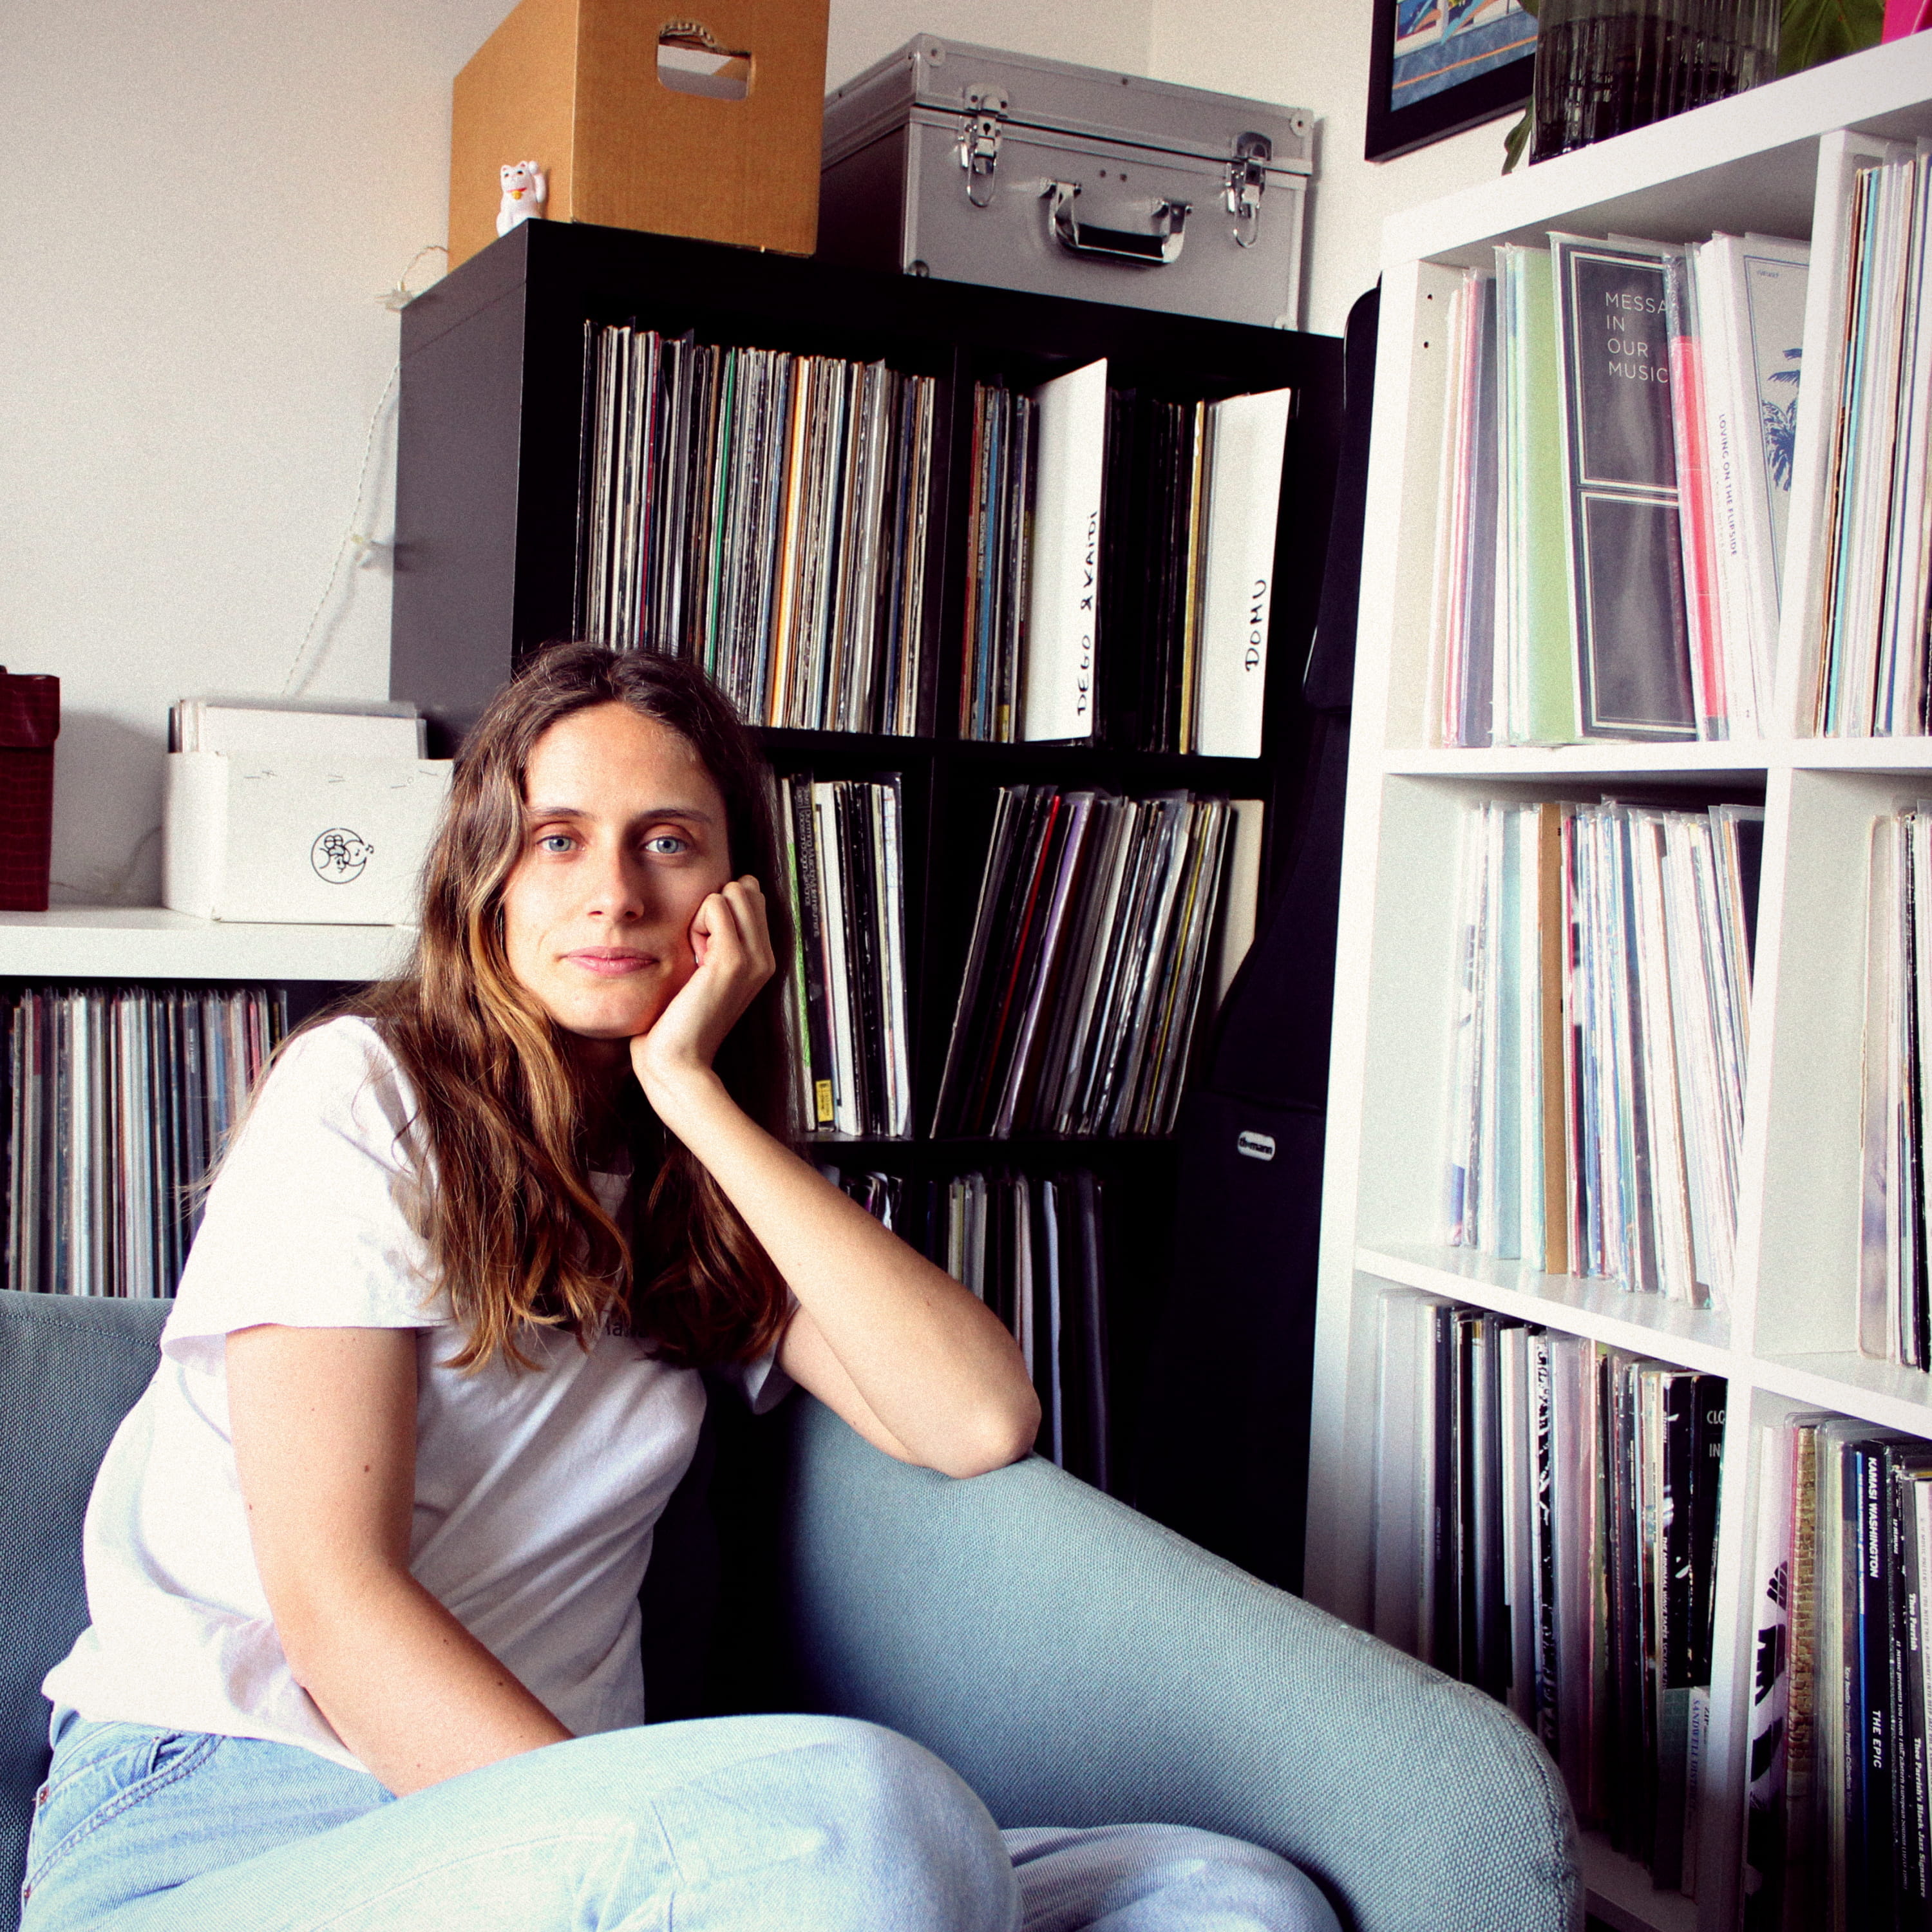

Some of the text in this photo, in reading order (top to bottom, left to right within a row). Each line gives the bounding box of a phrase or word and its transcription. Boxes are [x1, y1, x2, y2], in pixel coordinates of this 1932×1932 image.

[1607, 314, 1625, 332] IN
[1607, 338, 1649, 358] OUR
[1609, 361, 1669, 383] MUSIC
[1719, 413, 1729, 459] LOVING
[1723, 462, 1731, 481] ON
[1727, 508, 1738, 556] FLIPSIDE
[1244, 579, 1267, 672] DOMU
[1077, 634, 1092, 716] DEGO
[1868, 1457, 1879, 1578] KAMASI WASHINGTON
[1909, 1593, 1918, 1651] Theo Parrish
[1872, 1710, 1882, 1769] THE EPIC
[1913, 1738, 1922, 1760] Theo
[1915, 1761, 1924, 1802] Parrish's
[1918, 1853, 1926, 1898] Signature
